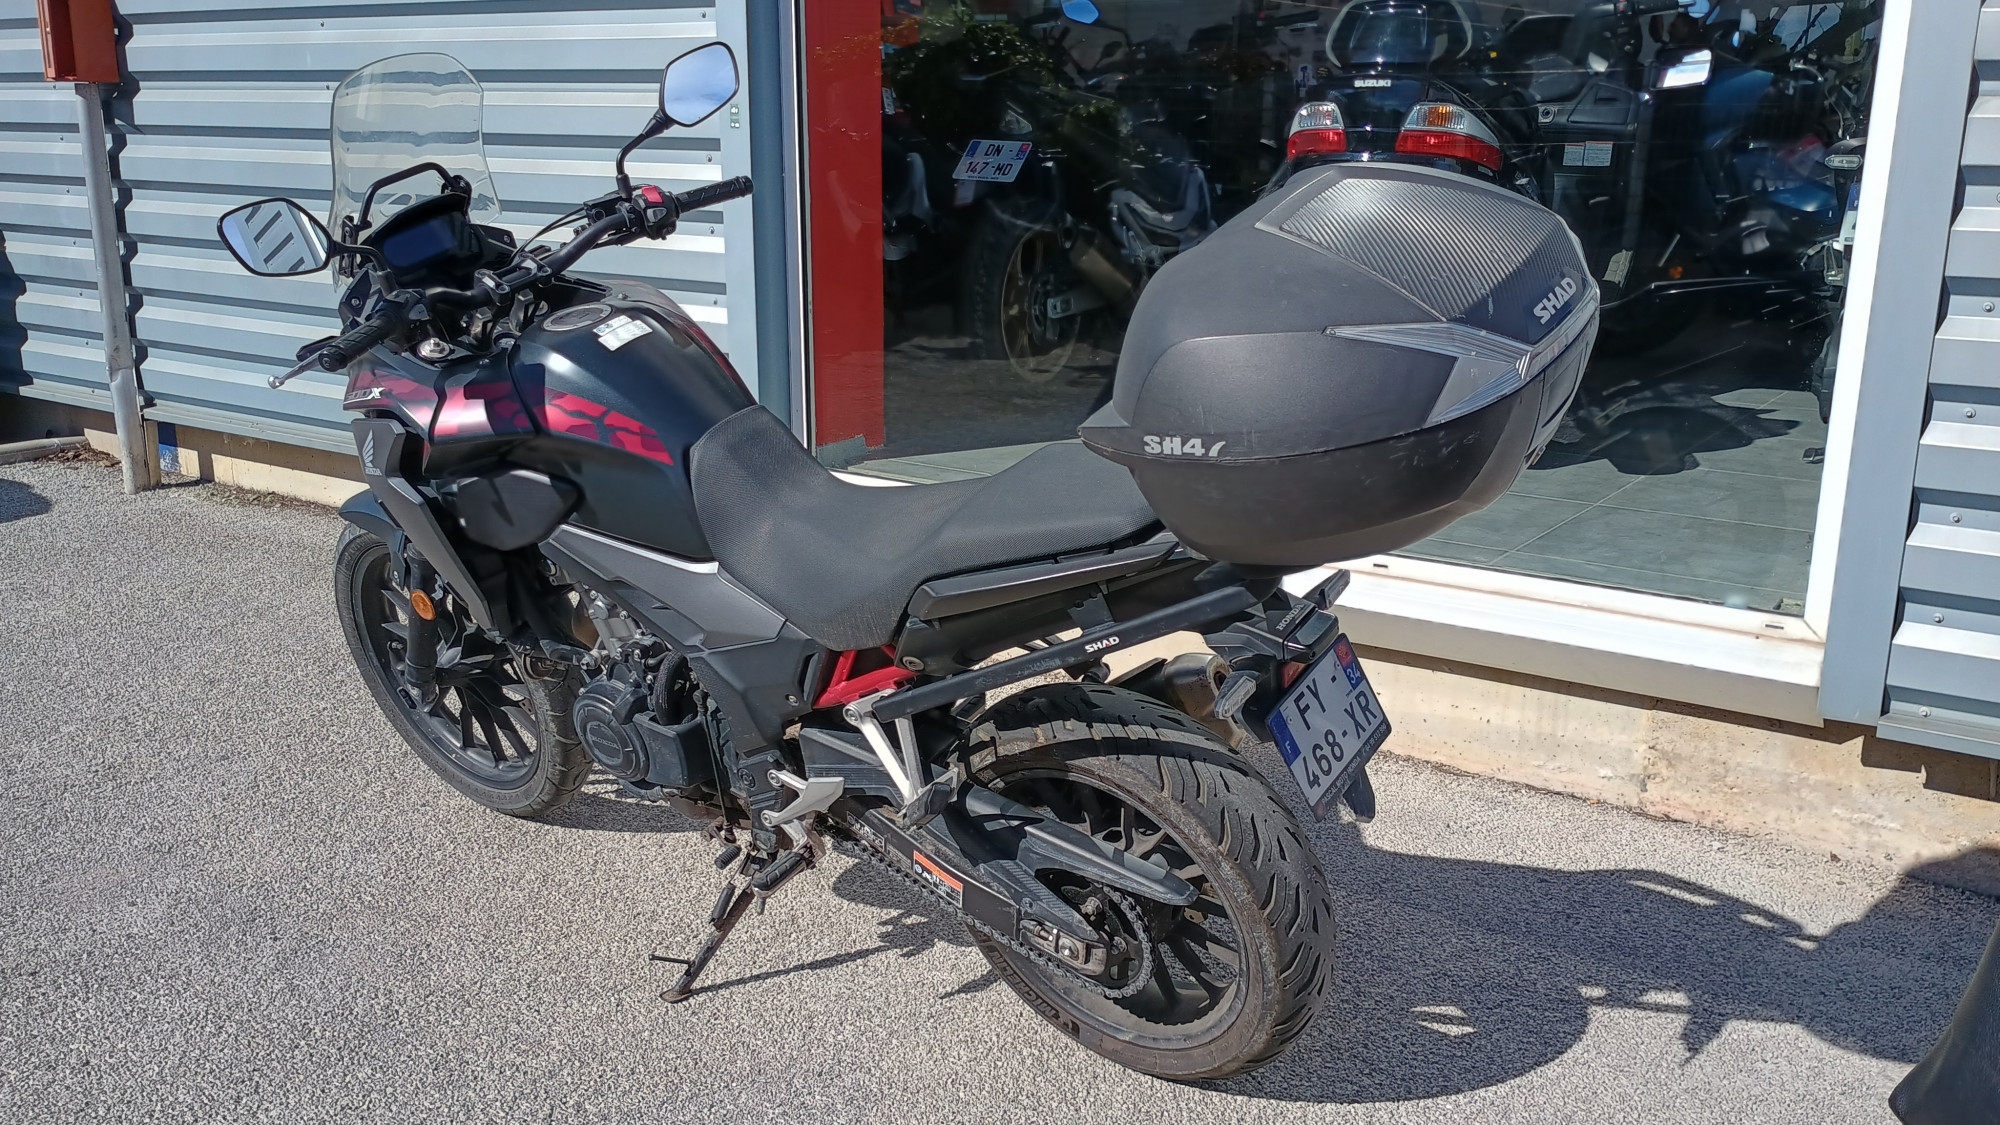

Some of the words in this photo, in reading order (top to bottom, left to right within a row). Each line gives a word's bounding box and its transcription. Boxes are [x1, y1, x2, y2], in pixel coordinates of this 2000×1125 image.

[1354, 79, 1391, 88] SUZUKI
[1533, 277, 1577, 325] SHAD
[1276, 603, 1305, 631] HONDA
[1085, 636, 1120, 653] SHAD
[1346, 663, 1360, 684] 34
[589, 735, 620, 750] HONDA
[1284, 740, 1292, 754] F
[1322, 785, 1339, 806] PASCAL
[1347, 756, 1360, 773] HONDA
[988, 948, 1057, 1017] MICHELIN
